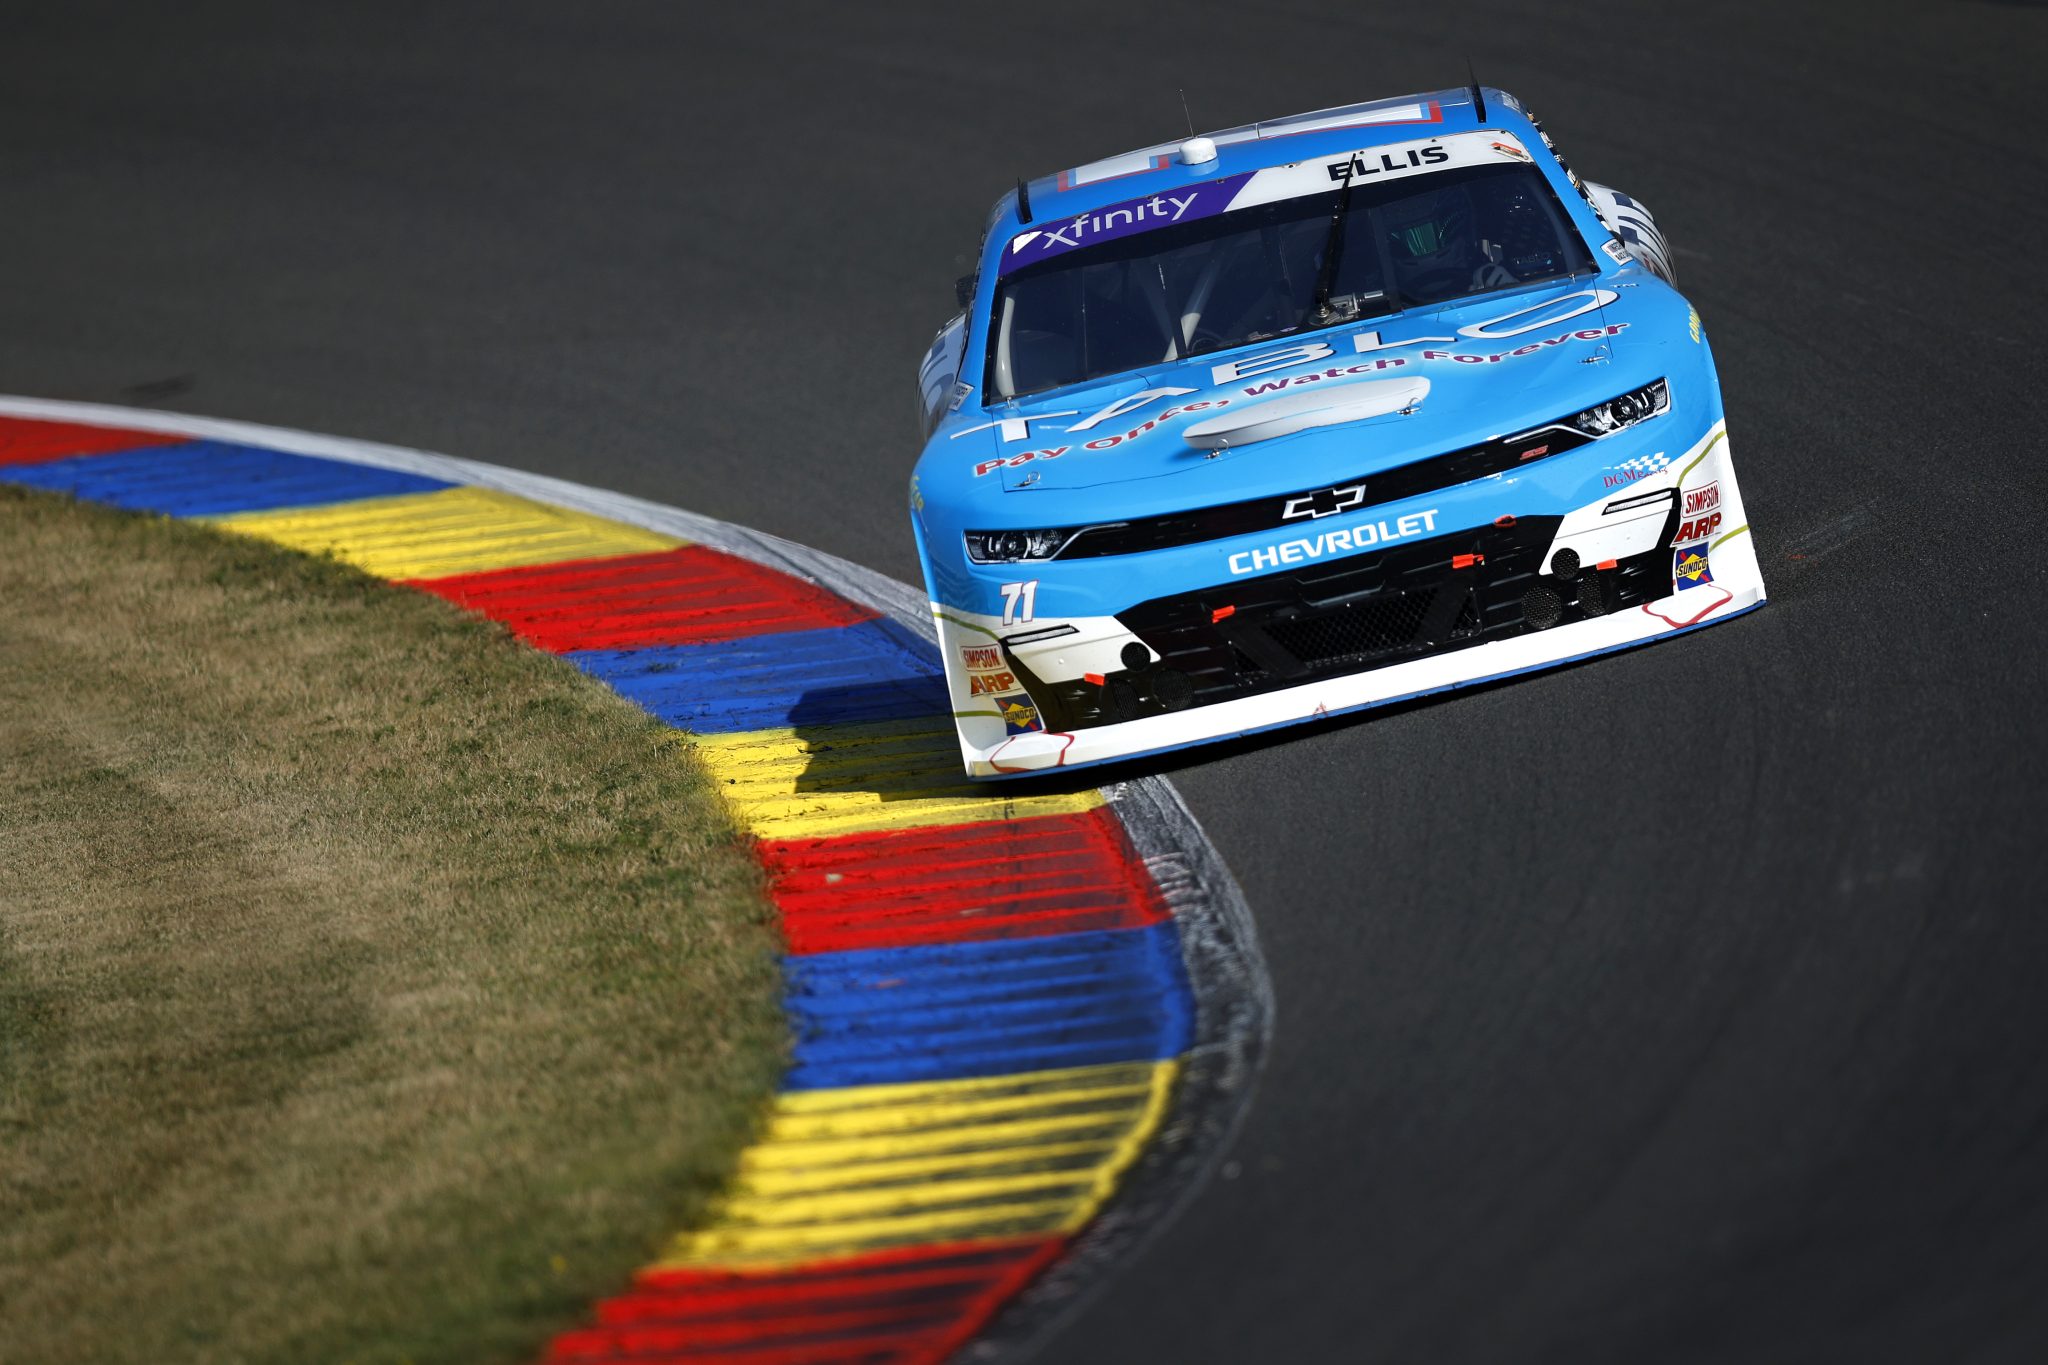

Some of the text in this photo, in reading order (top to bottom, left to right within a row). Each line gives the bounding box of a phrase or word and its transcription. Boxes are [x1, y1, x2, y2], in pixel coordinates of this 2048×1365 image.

[1327, 146, 1449, 182] ELLIS
[1042, 193, 1198, 249] xfinity
[950, 289, 1620, 442] TABLO
[973, 445, 1070, 477] Pay
[1243, 357, 1406, 396] Watch
[1423, 322, 1630, 364] Forever
[1686, 484, 1719, 514] SIMPSON
[1228, 509, 1438, 575] CHEVROLET
[1674, 512, 1722, 543] ARP
[1678, 558, 1708, 577] SUNOCO
[1000, 579, 1039, 627] 71
[963, 647, 1000, 668] SIMPSON
[971, 672, 1015, 696] ARP
[1005, 708, 1036, 721] SUNOCO
